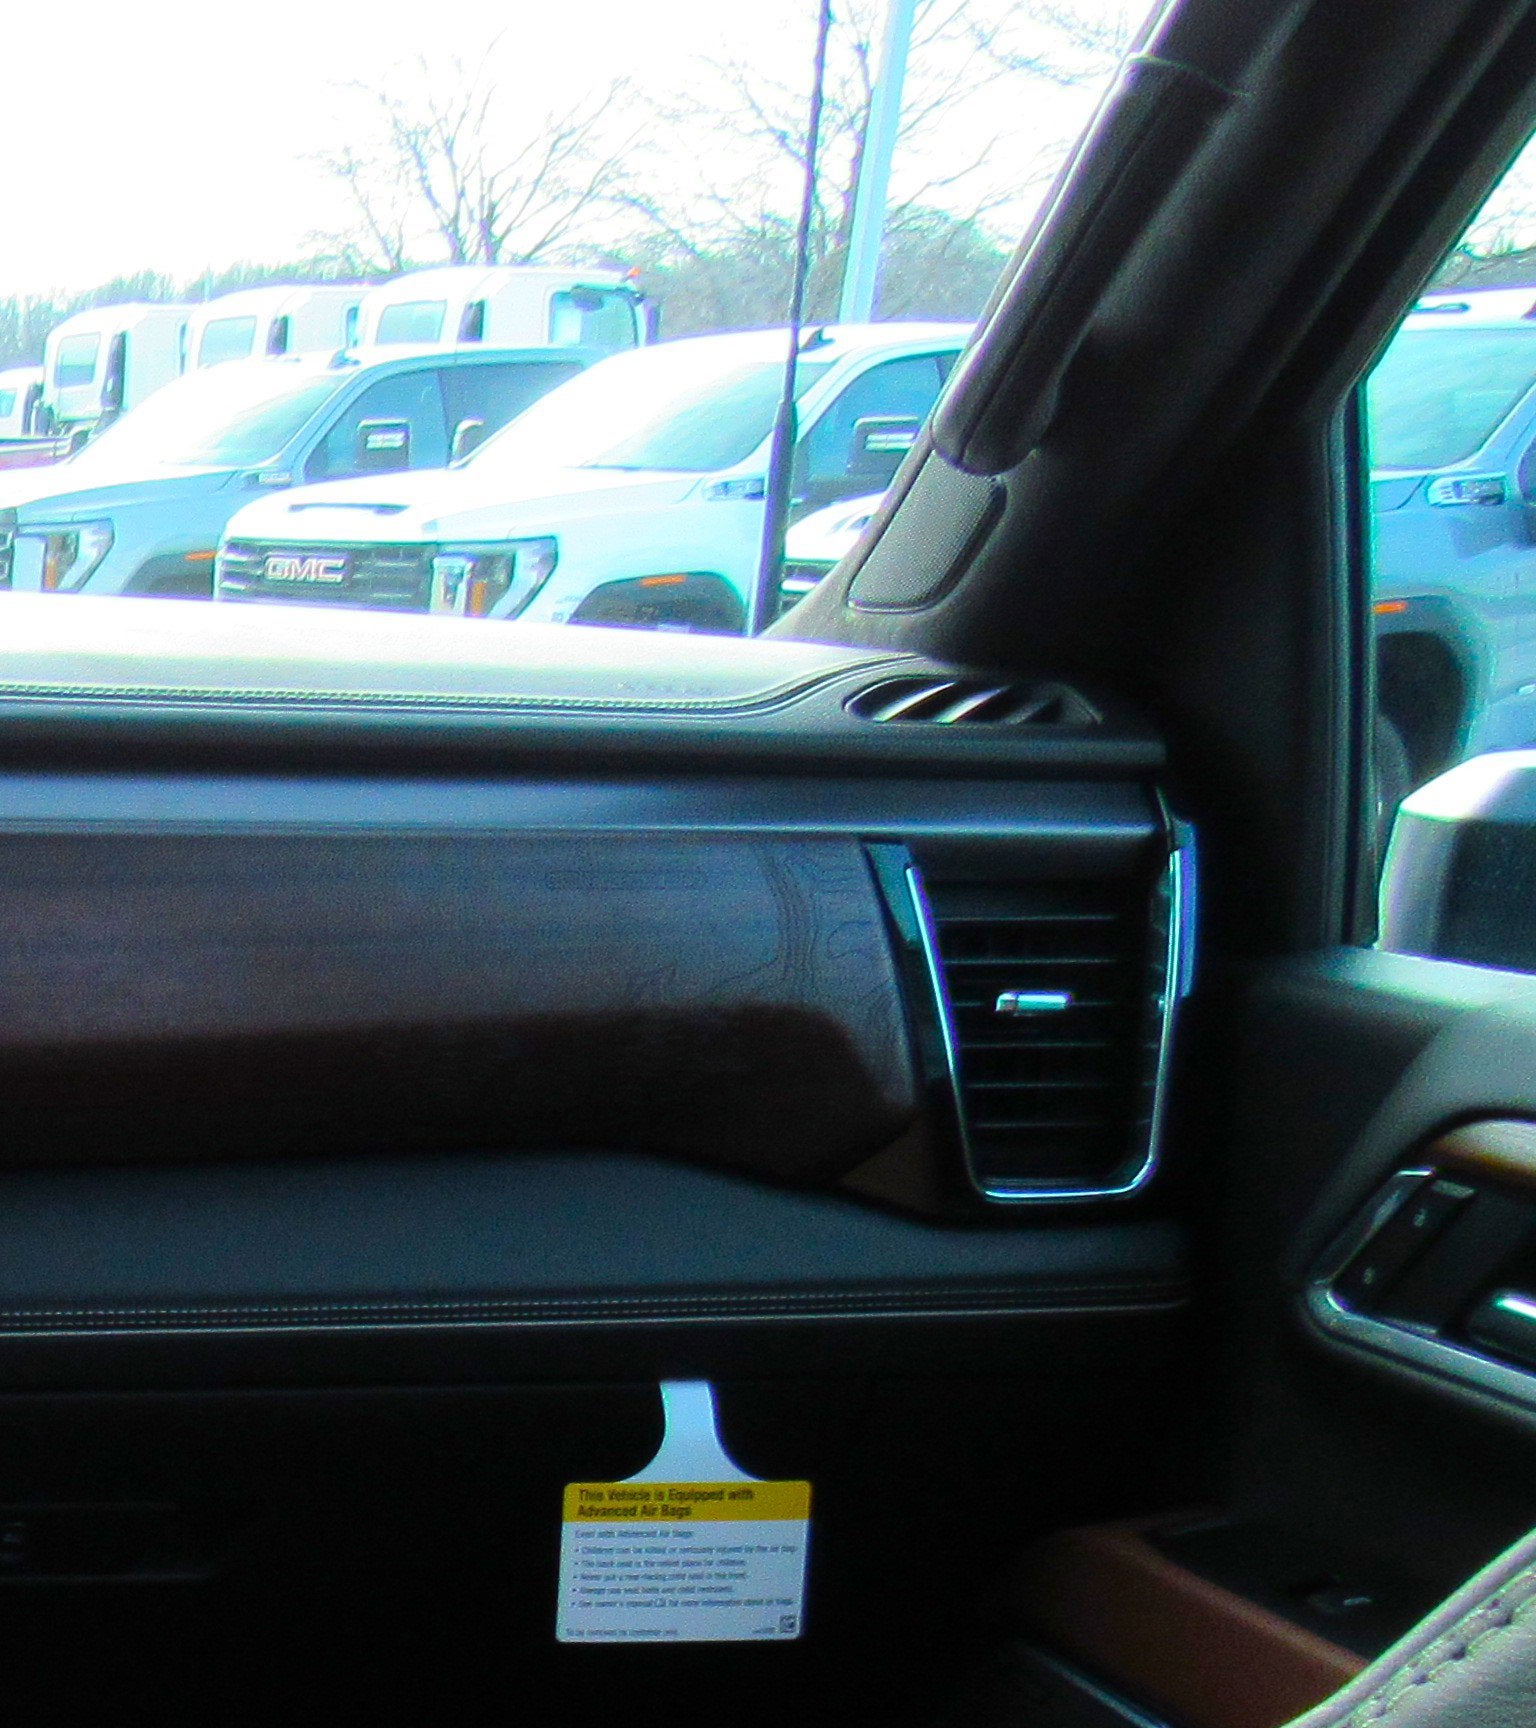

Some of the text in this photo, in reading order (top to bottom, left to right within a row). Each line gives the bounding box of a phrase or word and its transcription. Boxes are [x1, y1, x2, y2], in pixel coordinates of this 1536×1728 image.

[264, 555, 347, 583] GMC
[578, 1488, 754, 1504] This Vehicle is Equipped with
[577, 1505, 693, 1519] Advanced Air Bags
